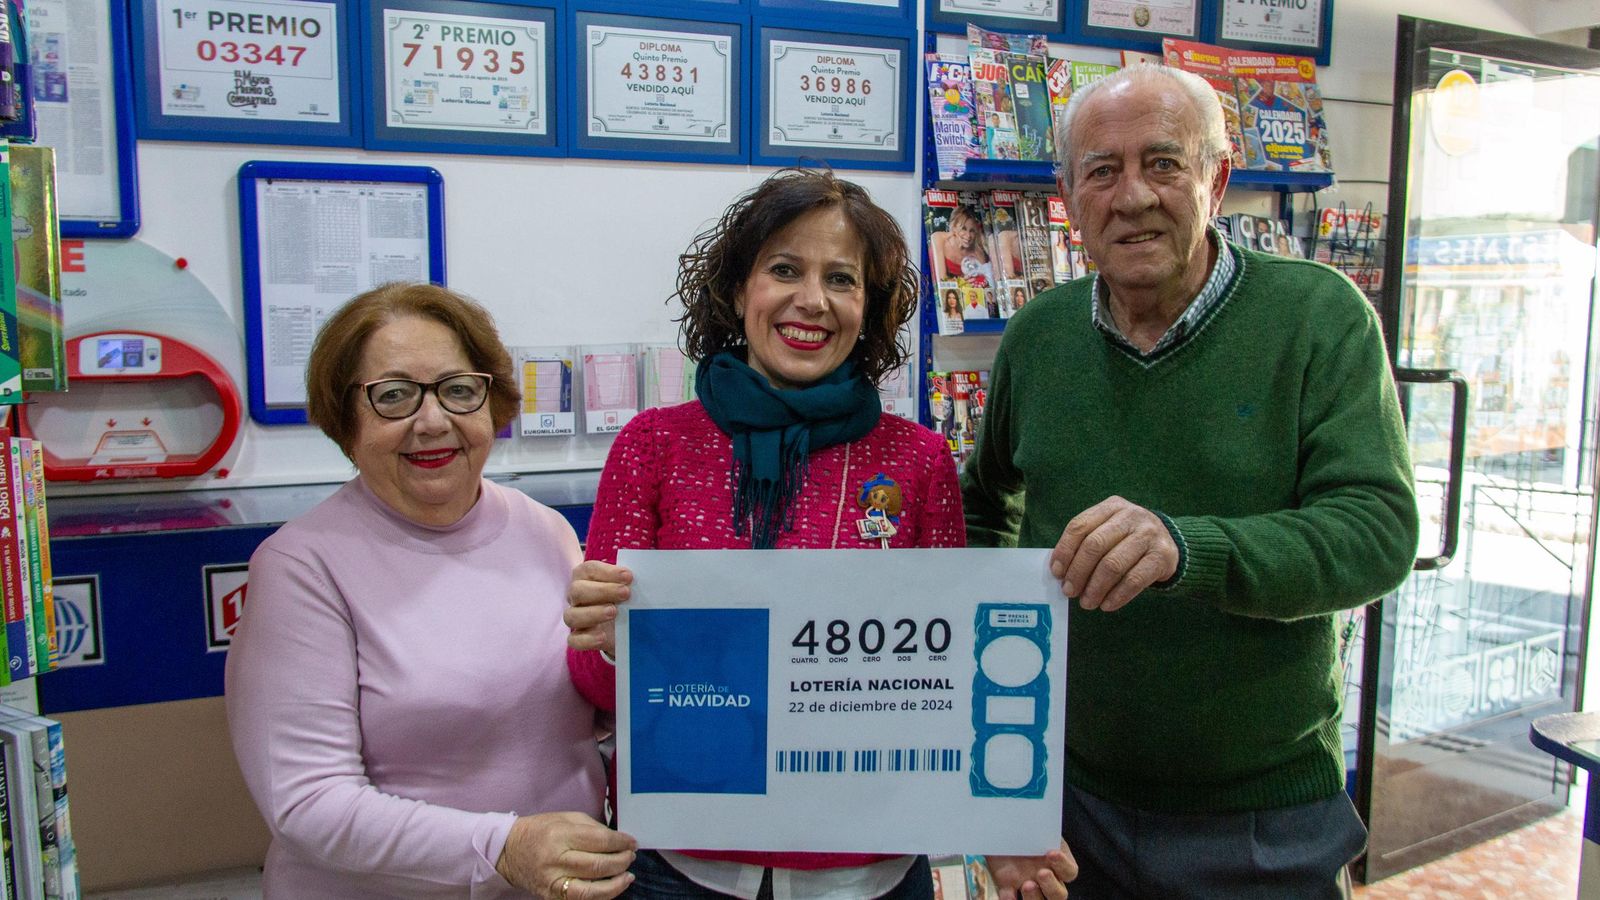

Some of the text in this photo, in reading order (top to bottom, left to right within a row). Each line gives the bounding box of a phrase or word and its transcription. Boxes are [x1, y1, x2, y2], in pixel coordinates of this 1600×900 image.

[208, 11, 321, 38] PREMIO
[441, 25, 516, 46] PREMIO
[197, 40, 307, 66] 03347
[640, 41, 682, 53] DIPLOMA
[403, 43, 525, 75] 71935
[633, 52, 688, 64] Quinto Premio
[817, 55, 855, 66] DIPLOMA
[1228, 55, 1275, 67] CALENDARIO
[621, 62, 698, 84] 43831
[811, 65, 861, 76] Quinto Premio
[626, 83, 695, 97] VENDIDO AQUÍ
[800, 75, 871, 95] 36986
[804, 95, 866, 107] VENDIDO AQUÍ
[1259, 109, 1303, 121] CALENDARIO
[935, 121, 960, 134] Mario
[1260, 119, 1306, 145] 2025
[936, 133, 966, 146] Switch
[791, 617, 952, 656] 48020
[668, 681, 729, 694] LOTERÍA DE
[790, 677, 954, 692] LOTERÍA NACIONAL
[668, 694, 751, 708] NAVIDAD
[789, 699, 953, 713] 22 de diciembre de 2024
